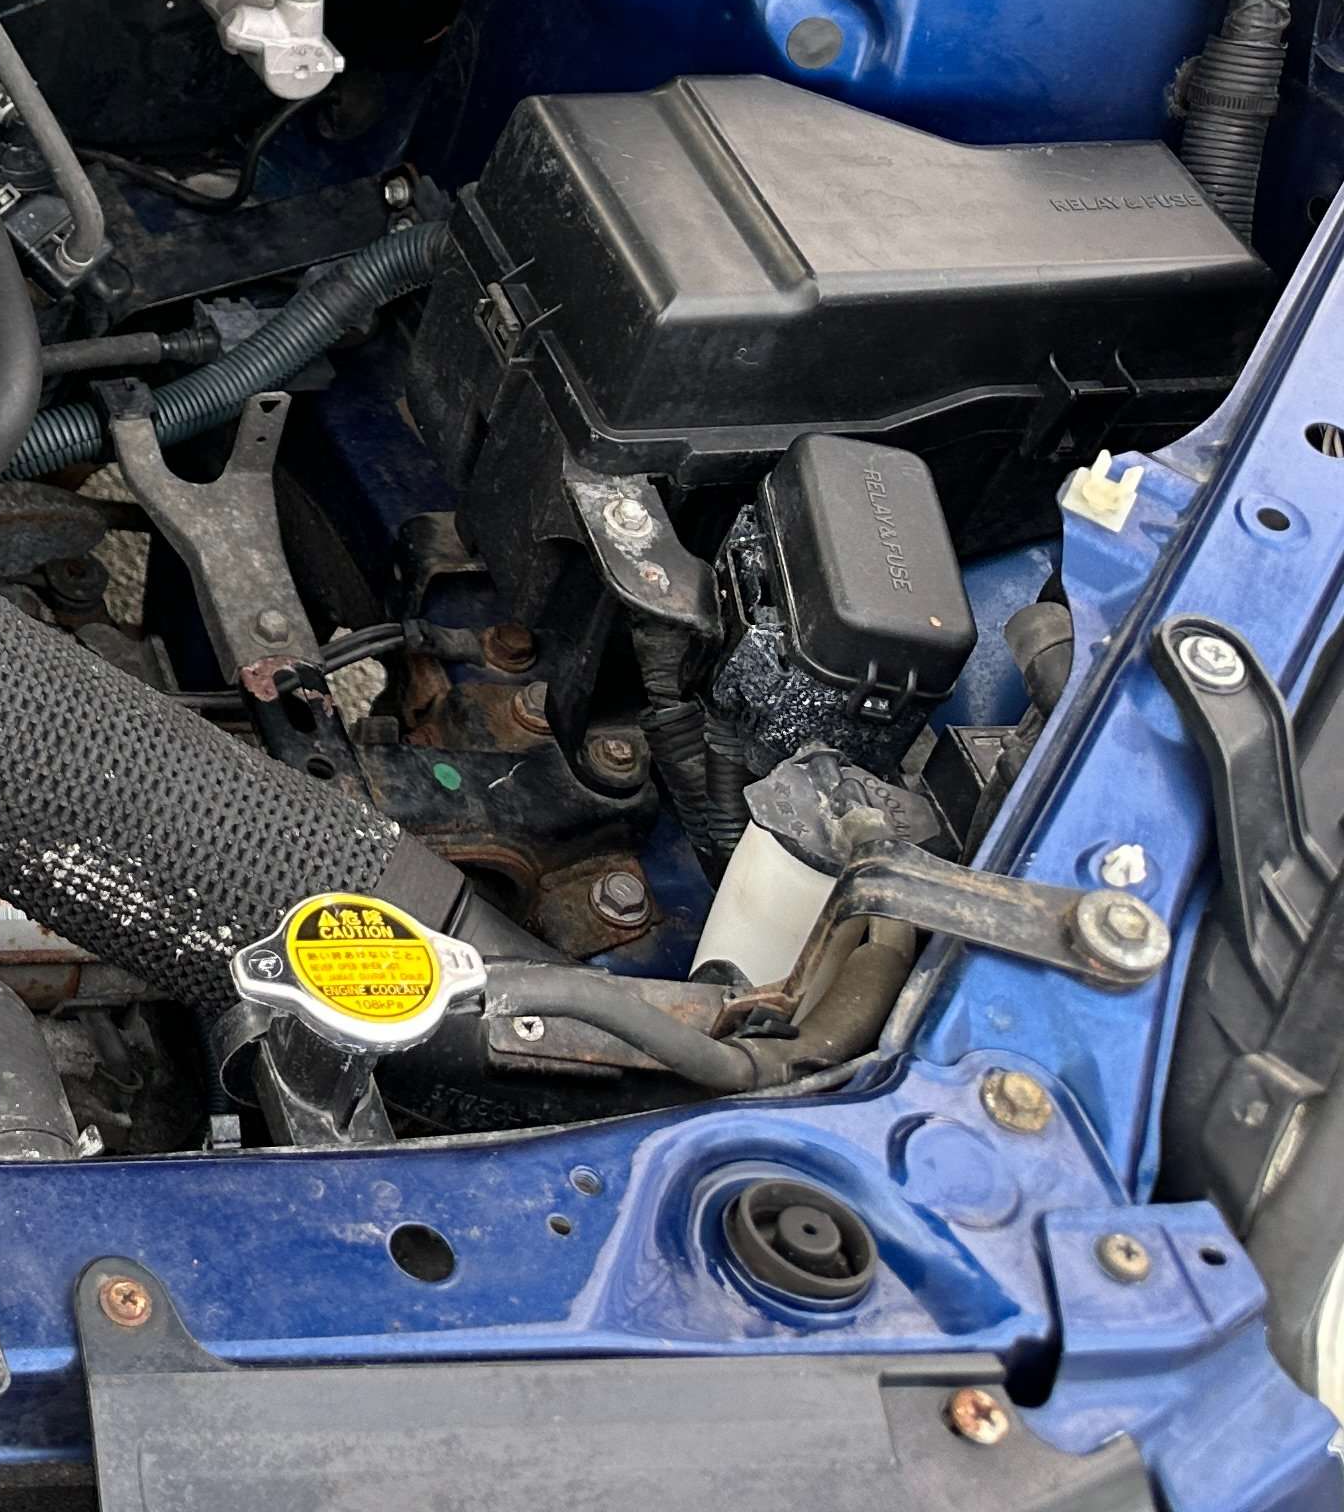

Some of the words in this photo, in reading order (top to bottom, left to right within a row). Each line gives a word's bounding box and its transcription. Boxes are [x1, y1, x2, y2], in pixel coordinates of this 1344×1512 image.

[1048, 196, 1120, 213] RELAY
[1140, 192, 1203, 209] FUSE
[319, 925, 395, 939] CAUTION
[322, 984, 367, 996] ENGINE
[370, 984, 426, 996] COOLANT
